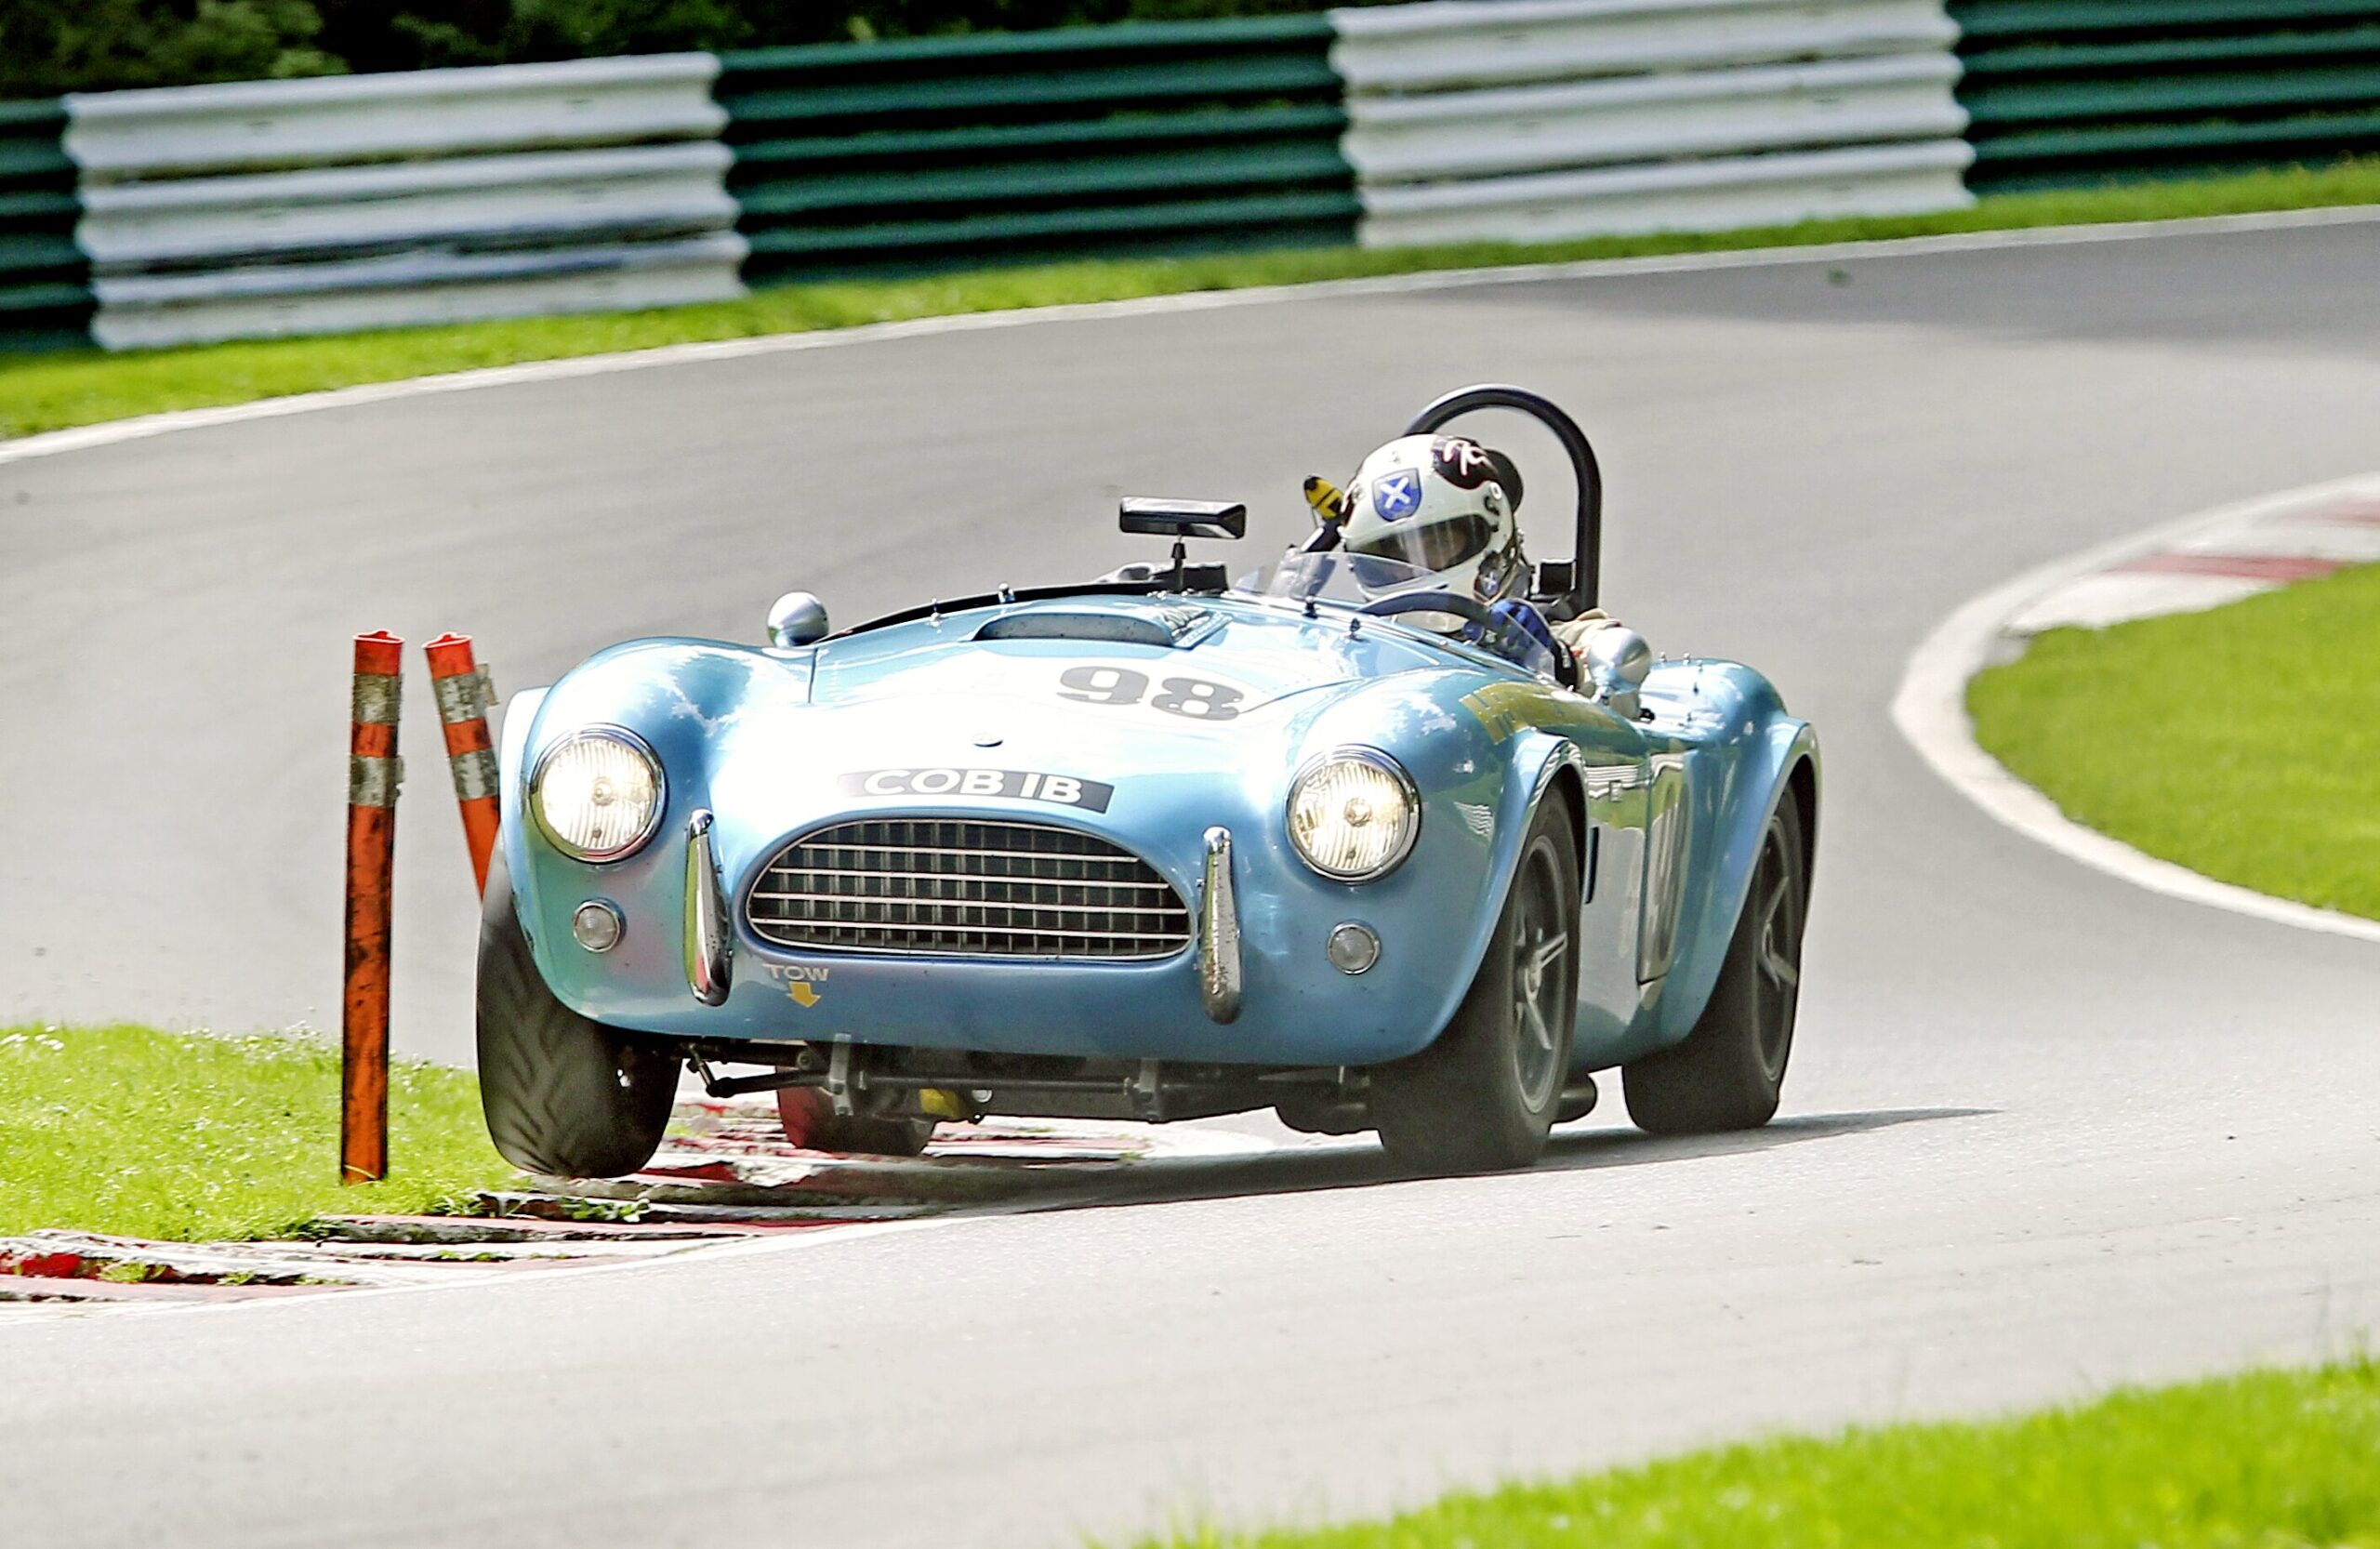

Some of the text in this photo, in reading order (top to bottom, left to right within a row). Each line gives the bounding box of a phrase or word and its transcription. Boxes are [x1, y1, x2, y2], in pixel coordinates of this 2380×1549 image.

[1055, 666, 1245, 722] 98
[863, 768, 1005, 795] COB
[761, 963, 829, 982] TOW
